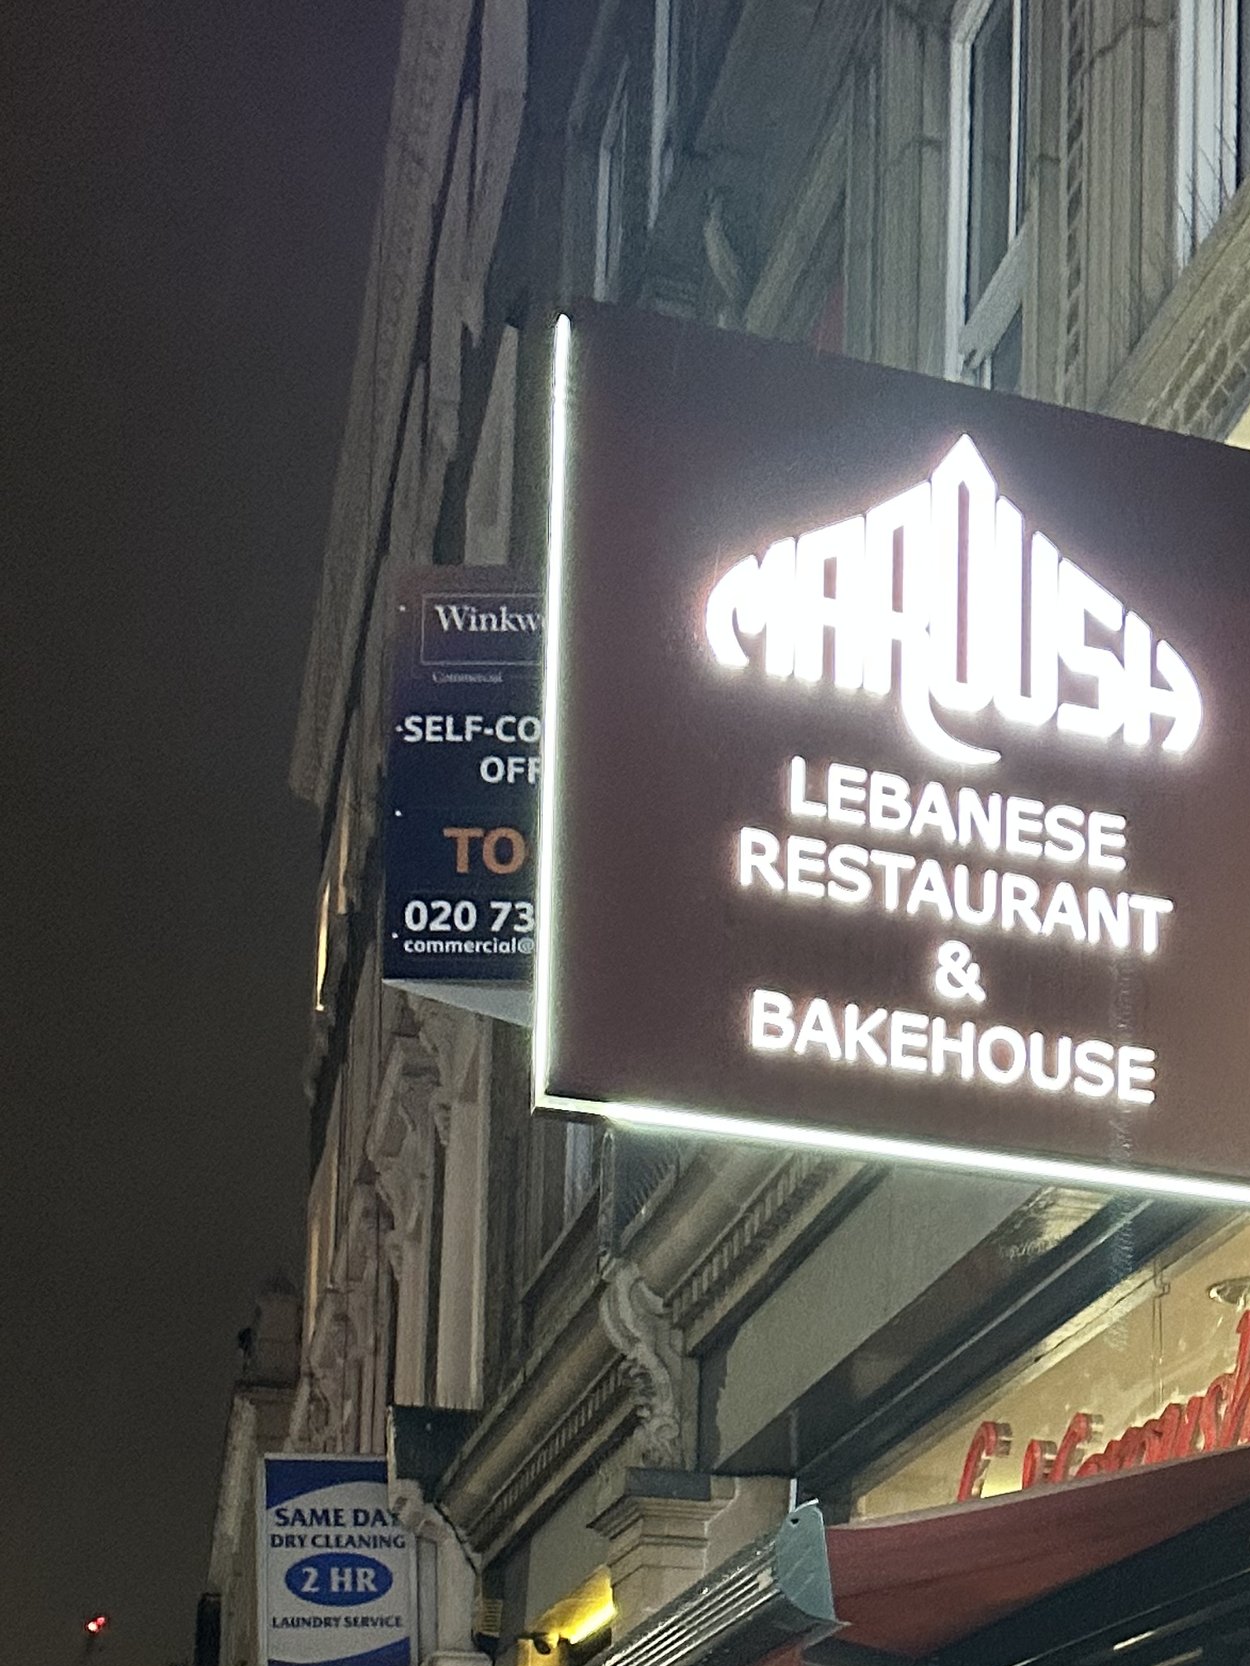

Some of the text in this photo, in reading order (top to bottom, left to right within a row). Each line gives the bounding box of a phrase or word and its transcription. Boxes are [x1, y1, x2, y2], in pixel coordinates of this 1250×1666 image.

[705, 432, 1202, 765] MAROUSH
[403, 715, 542, 742] SELF-CO
[788, 754, 1128, 872] LEBANESE
[442, 827, 526, 874] TO
[737, 826, 1174, 954] RESTAURANT
[404, 900, 535, 932] 020 73
[403, 937, 535, 954] commercial@
[935, 940, 986, 1002] &
[750, 988, 1157, 1104] BAKEHOUSE
[274, 1508, 345, 1527] SAME
[270, 1534, 406, 1549] DRY CLEANING
[301, 1567, 378, 1593] 2 HR
[272, 1615, 402, 1628] LAUNDRY SERVICE
